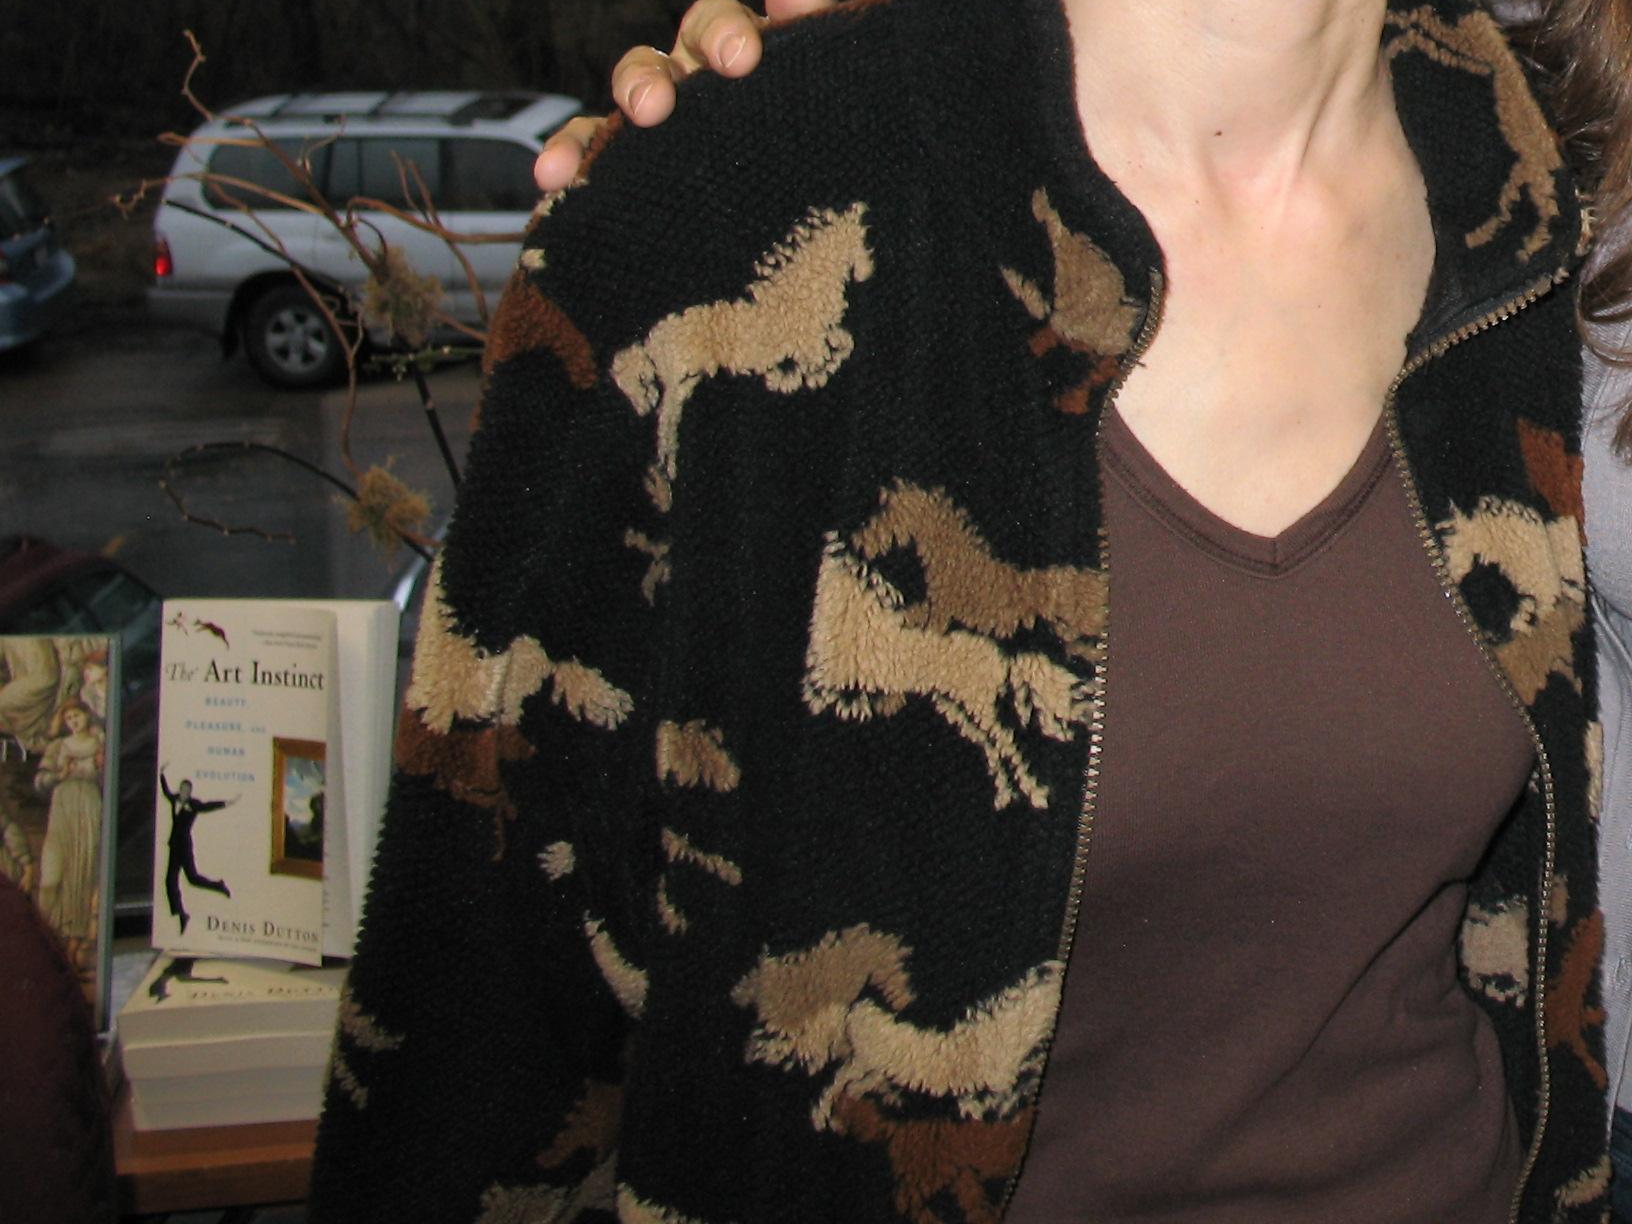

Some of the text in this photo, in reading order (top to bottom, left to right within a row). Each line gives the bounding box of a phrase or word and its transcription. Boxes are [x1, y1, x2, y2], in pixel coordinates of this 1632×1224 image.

[165, 658, 325, 691] The Art Instinct
[207, 746, 246, 757] HUMAN
[195, 769, 256, 783] EVOLUTION
[206, 915, 257, 934] DENIS
[262, 920, 320, 944] DUTTON
